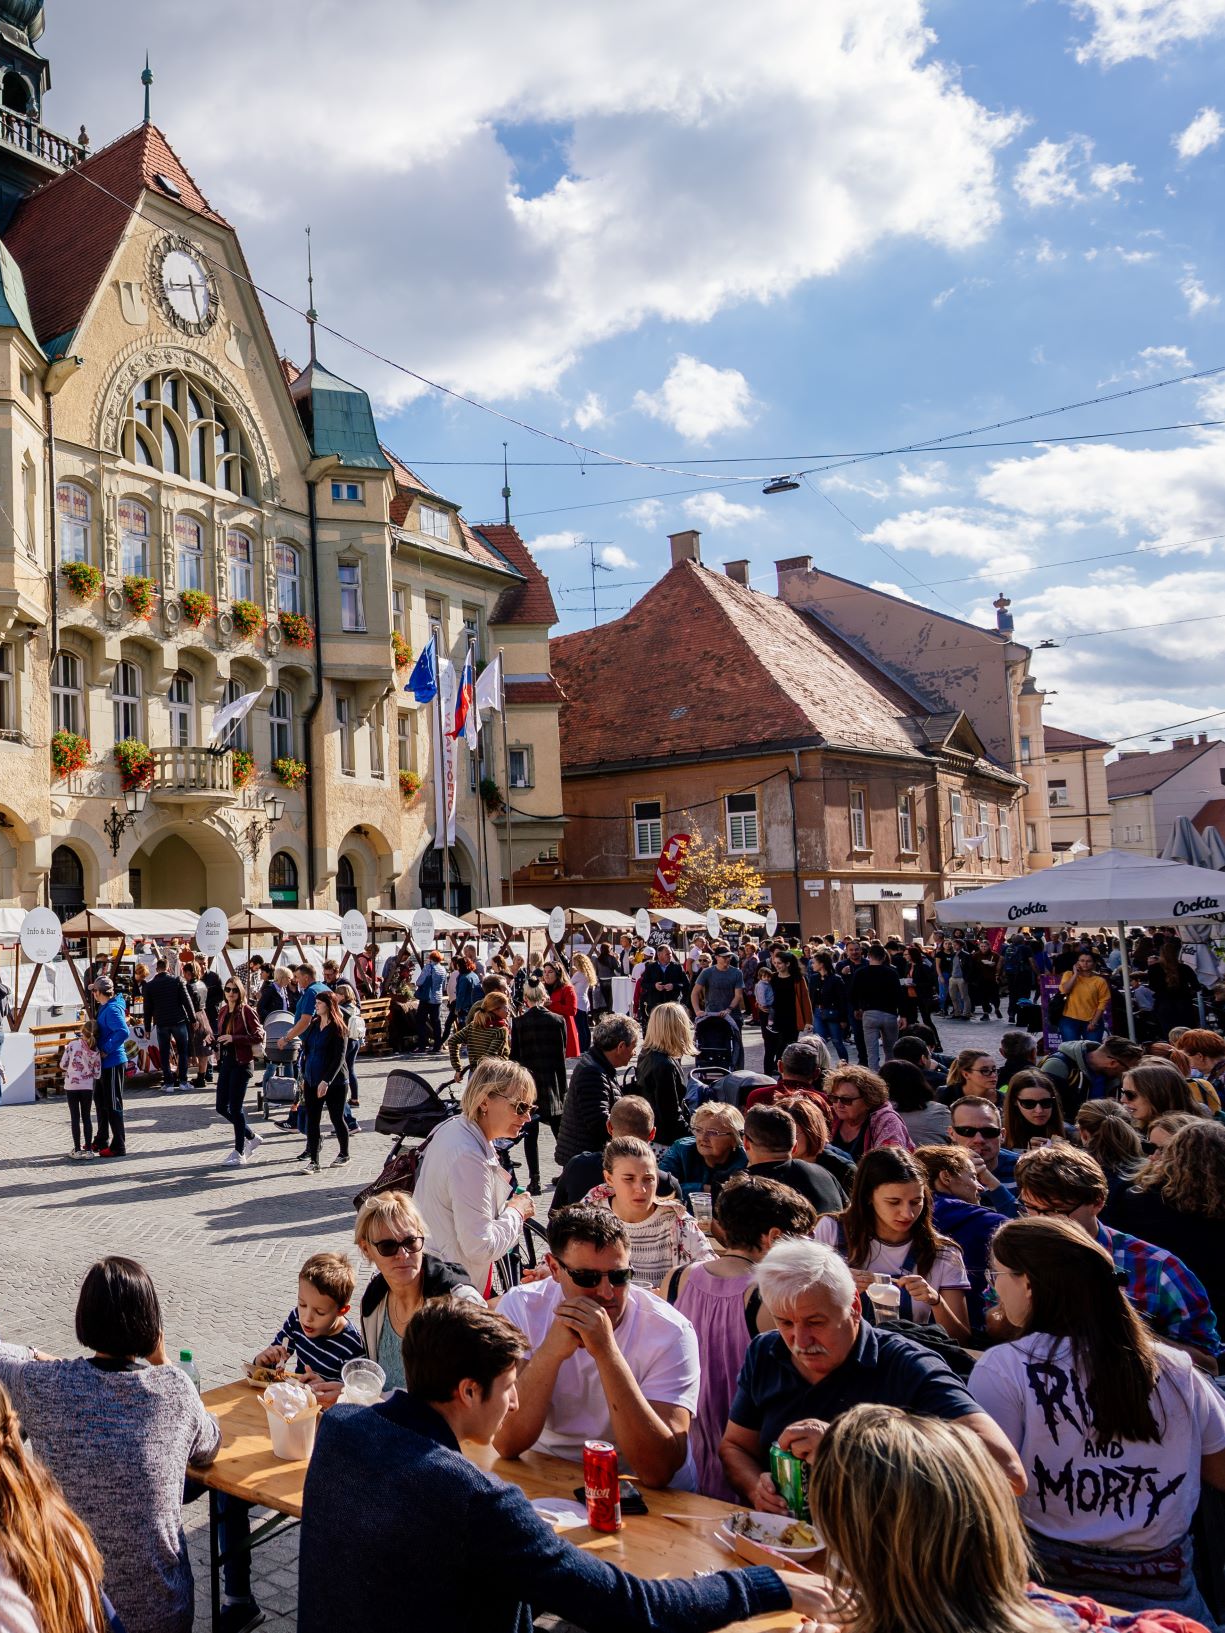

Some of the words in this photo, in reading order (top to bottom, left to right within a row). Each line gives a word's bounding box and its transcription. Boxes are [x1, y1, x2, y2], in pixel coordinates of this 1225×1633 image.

[1008, 902, 1048, 920] Cockta
[1173, 896, 1220, 917] Cockta
[1083, 1438, 1125, 1459] AND
[1031, 1454, 1187, 1529] MORTY
